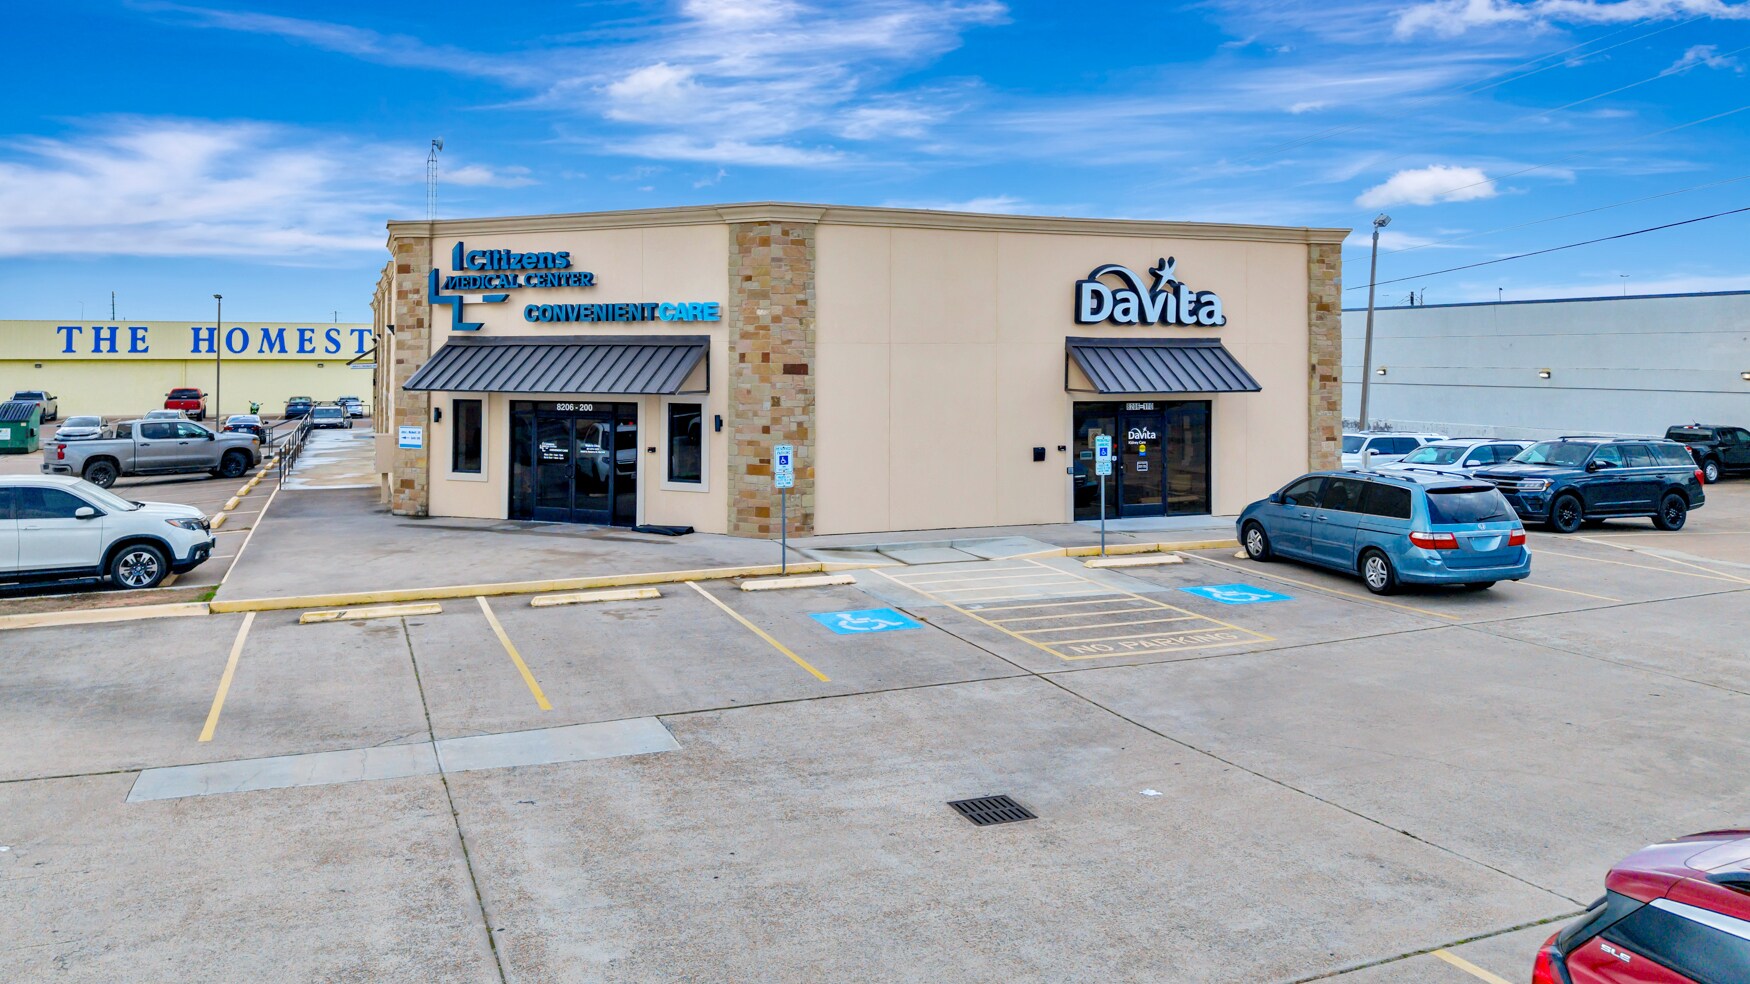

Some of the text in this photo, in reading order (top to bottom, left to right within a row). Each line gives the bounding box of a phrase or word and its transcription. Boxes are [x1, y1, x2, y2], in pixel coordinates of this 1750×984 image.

[465, 249, 571, 271] Citizens
[442, 271, 595, 290] MEDICAL CENTER
[1075, 263, 1223, 326] DaVita
[57, 325, 150, 354] THE
[556, 403, 574, 412] 8206
[579, 404, 593, 412] 200
[1128, 428, 1156, 440] DaVita
[1067, 632, 1238, 655] NO PARKING
[1600, 943, 1631, 963] SLE
